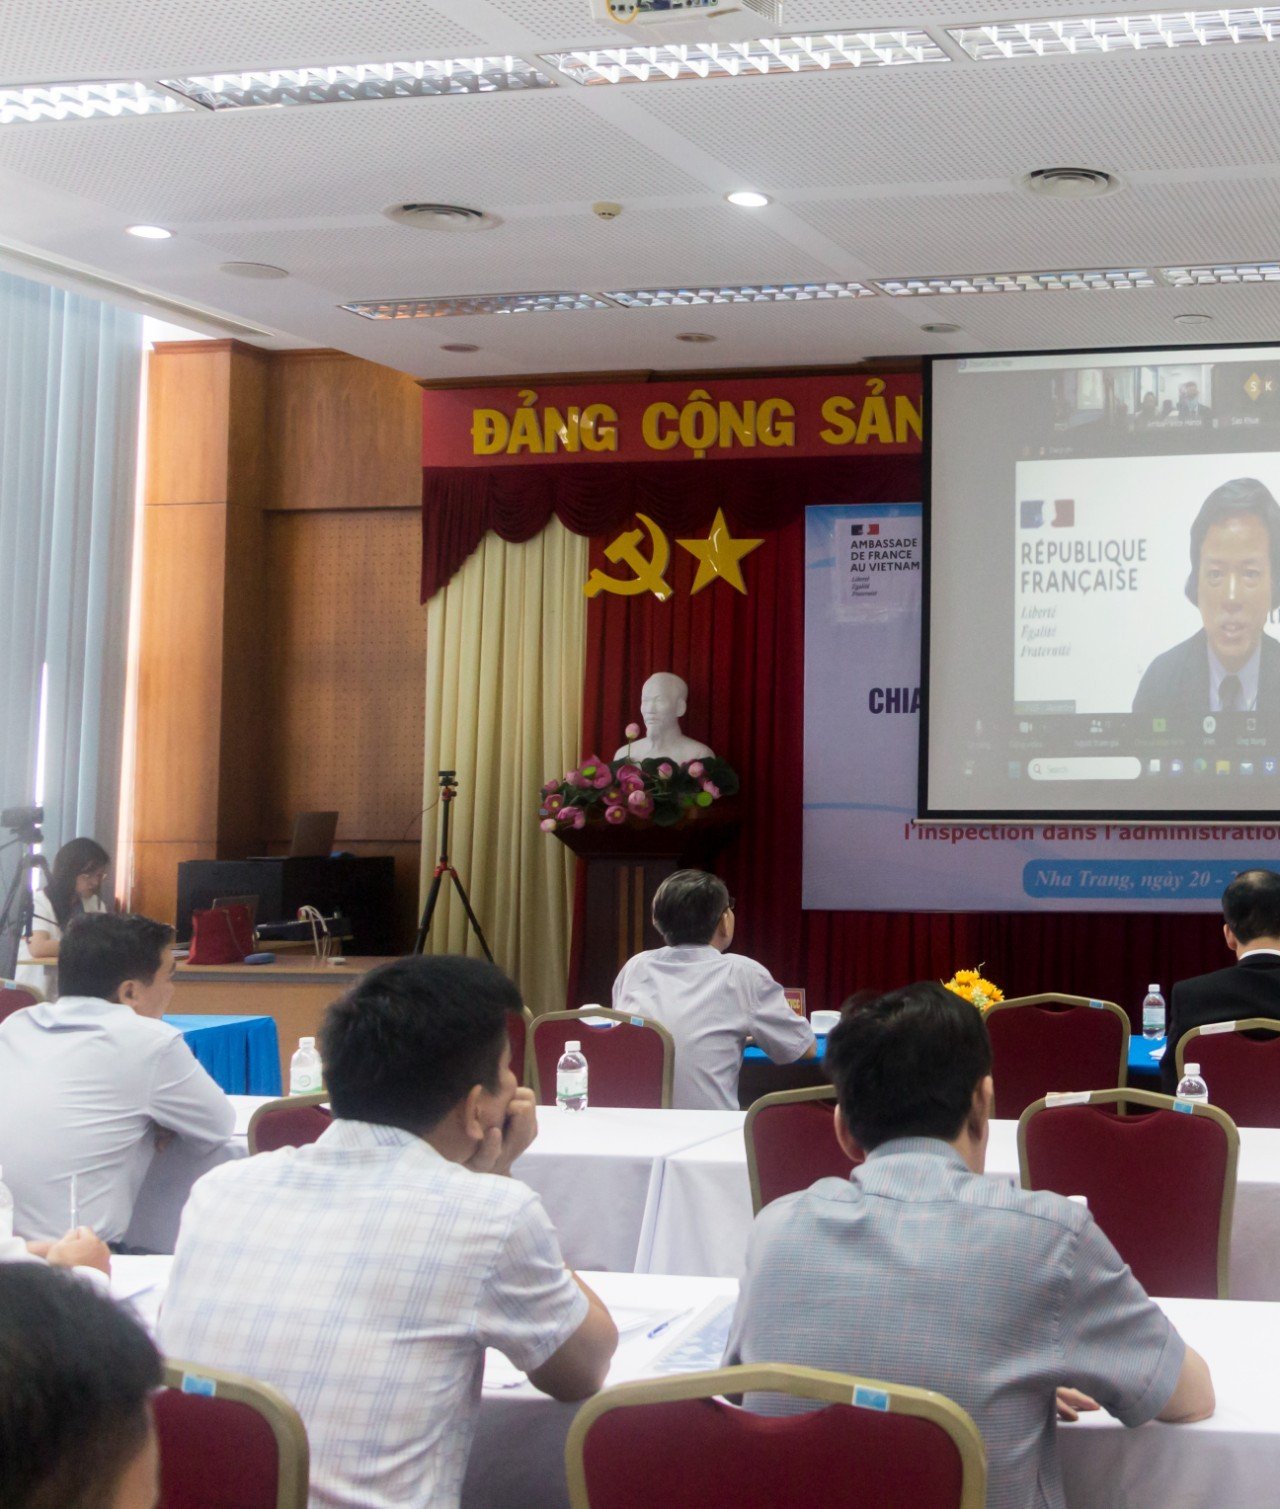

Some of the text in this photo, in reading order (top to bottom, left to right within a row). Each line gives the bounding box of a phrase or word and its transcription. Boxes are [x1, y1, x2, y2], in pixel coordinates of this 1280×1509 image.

[470, 389, 618, 456] ĐẢNG
[642, 388, 796, 459] CỘNG
[819, 378, 923, 446] SẢN
[850, 538, 918, 549] AMBASSADE
[851, 549, 912, 561] DE FRANCE
[1021, 538, 1147, 566] RÉPUBLIQUE
[850, 561, 920, 572] AU VIETNAM
[1020, 568, 1138, 595] FRANÇAISE
[868, 687, 921, 715] CHIA
[1042, 824, 1097, 840] dans
[1035, 869, 1072, 887] Nha
[1079, 869, 1134, 892] Trang,
[1140, 870, 1184, 892] ngày
[1187, 870, 1211, 887] 20
